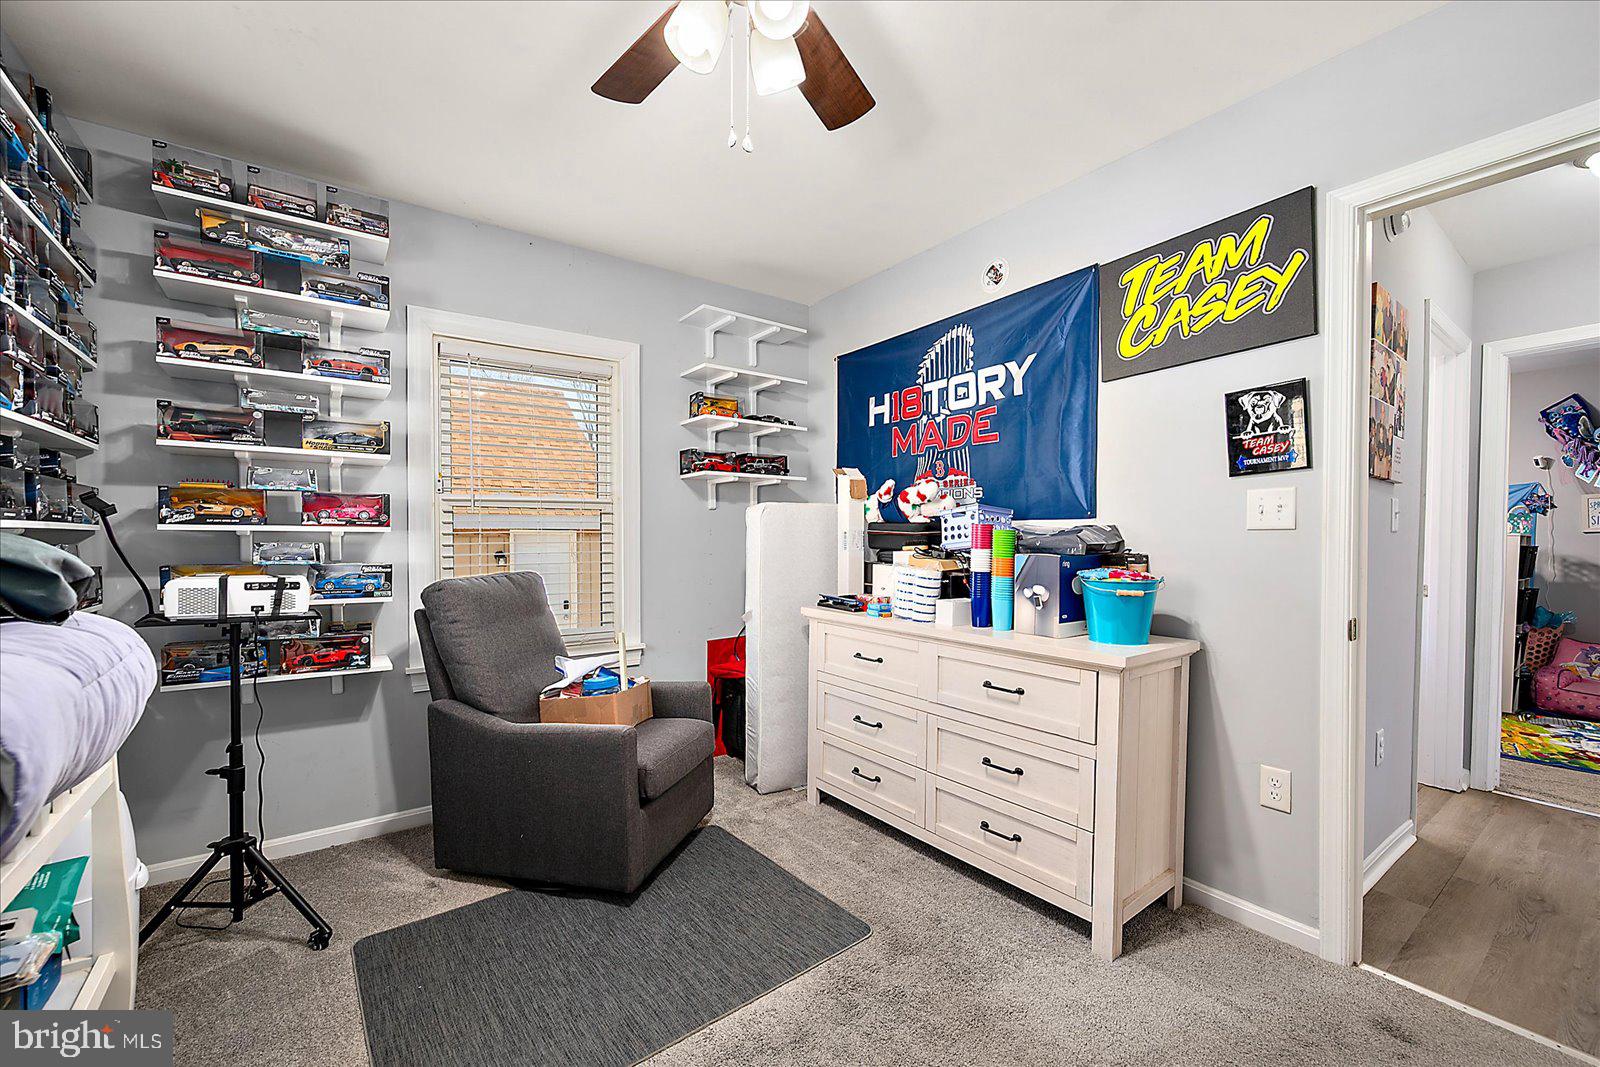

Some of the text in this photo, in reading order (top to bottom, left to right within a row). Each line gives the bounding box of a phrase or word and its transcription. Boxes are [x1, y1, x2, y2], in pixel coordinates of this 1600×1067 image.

[1120, 215, 1272, 318] TEAM
[1118, 250, 1308, 359] CASEY
[892, 405, 999, 458] MADE
[1242, 434, 1275, 449] TEAM
[1252, 440, 1290, 455] CASEY
[935, 460, 945, 477] B
[1243, 457, 1277, 465] TOURNAMENT
[943, 478, 975, 488] SERIES
[936, 487, 984, 499] PIONS
